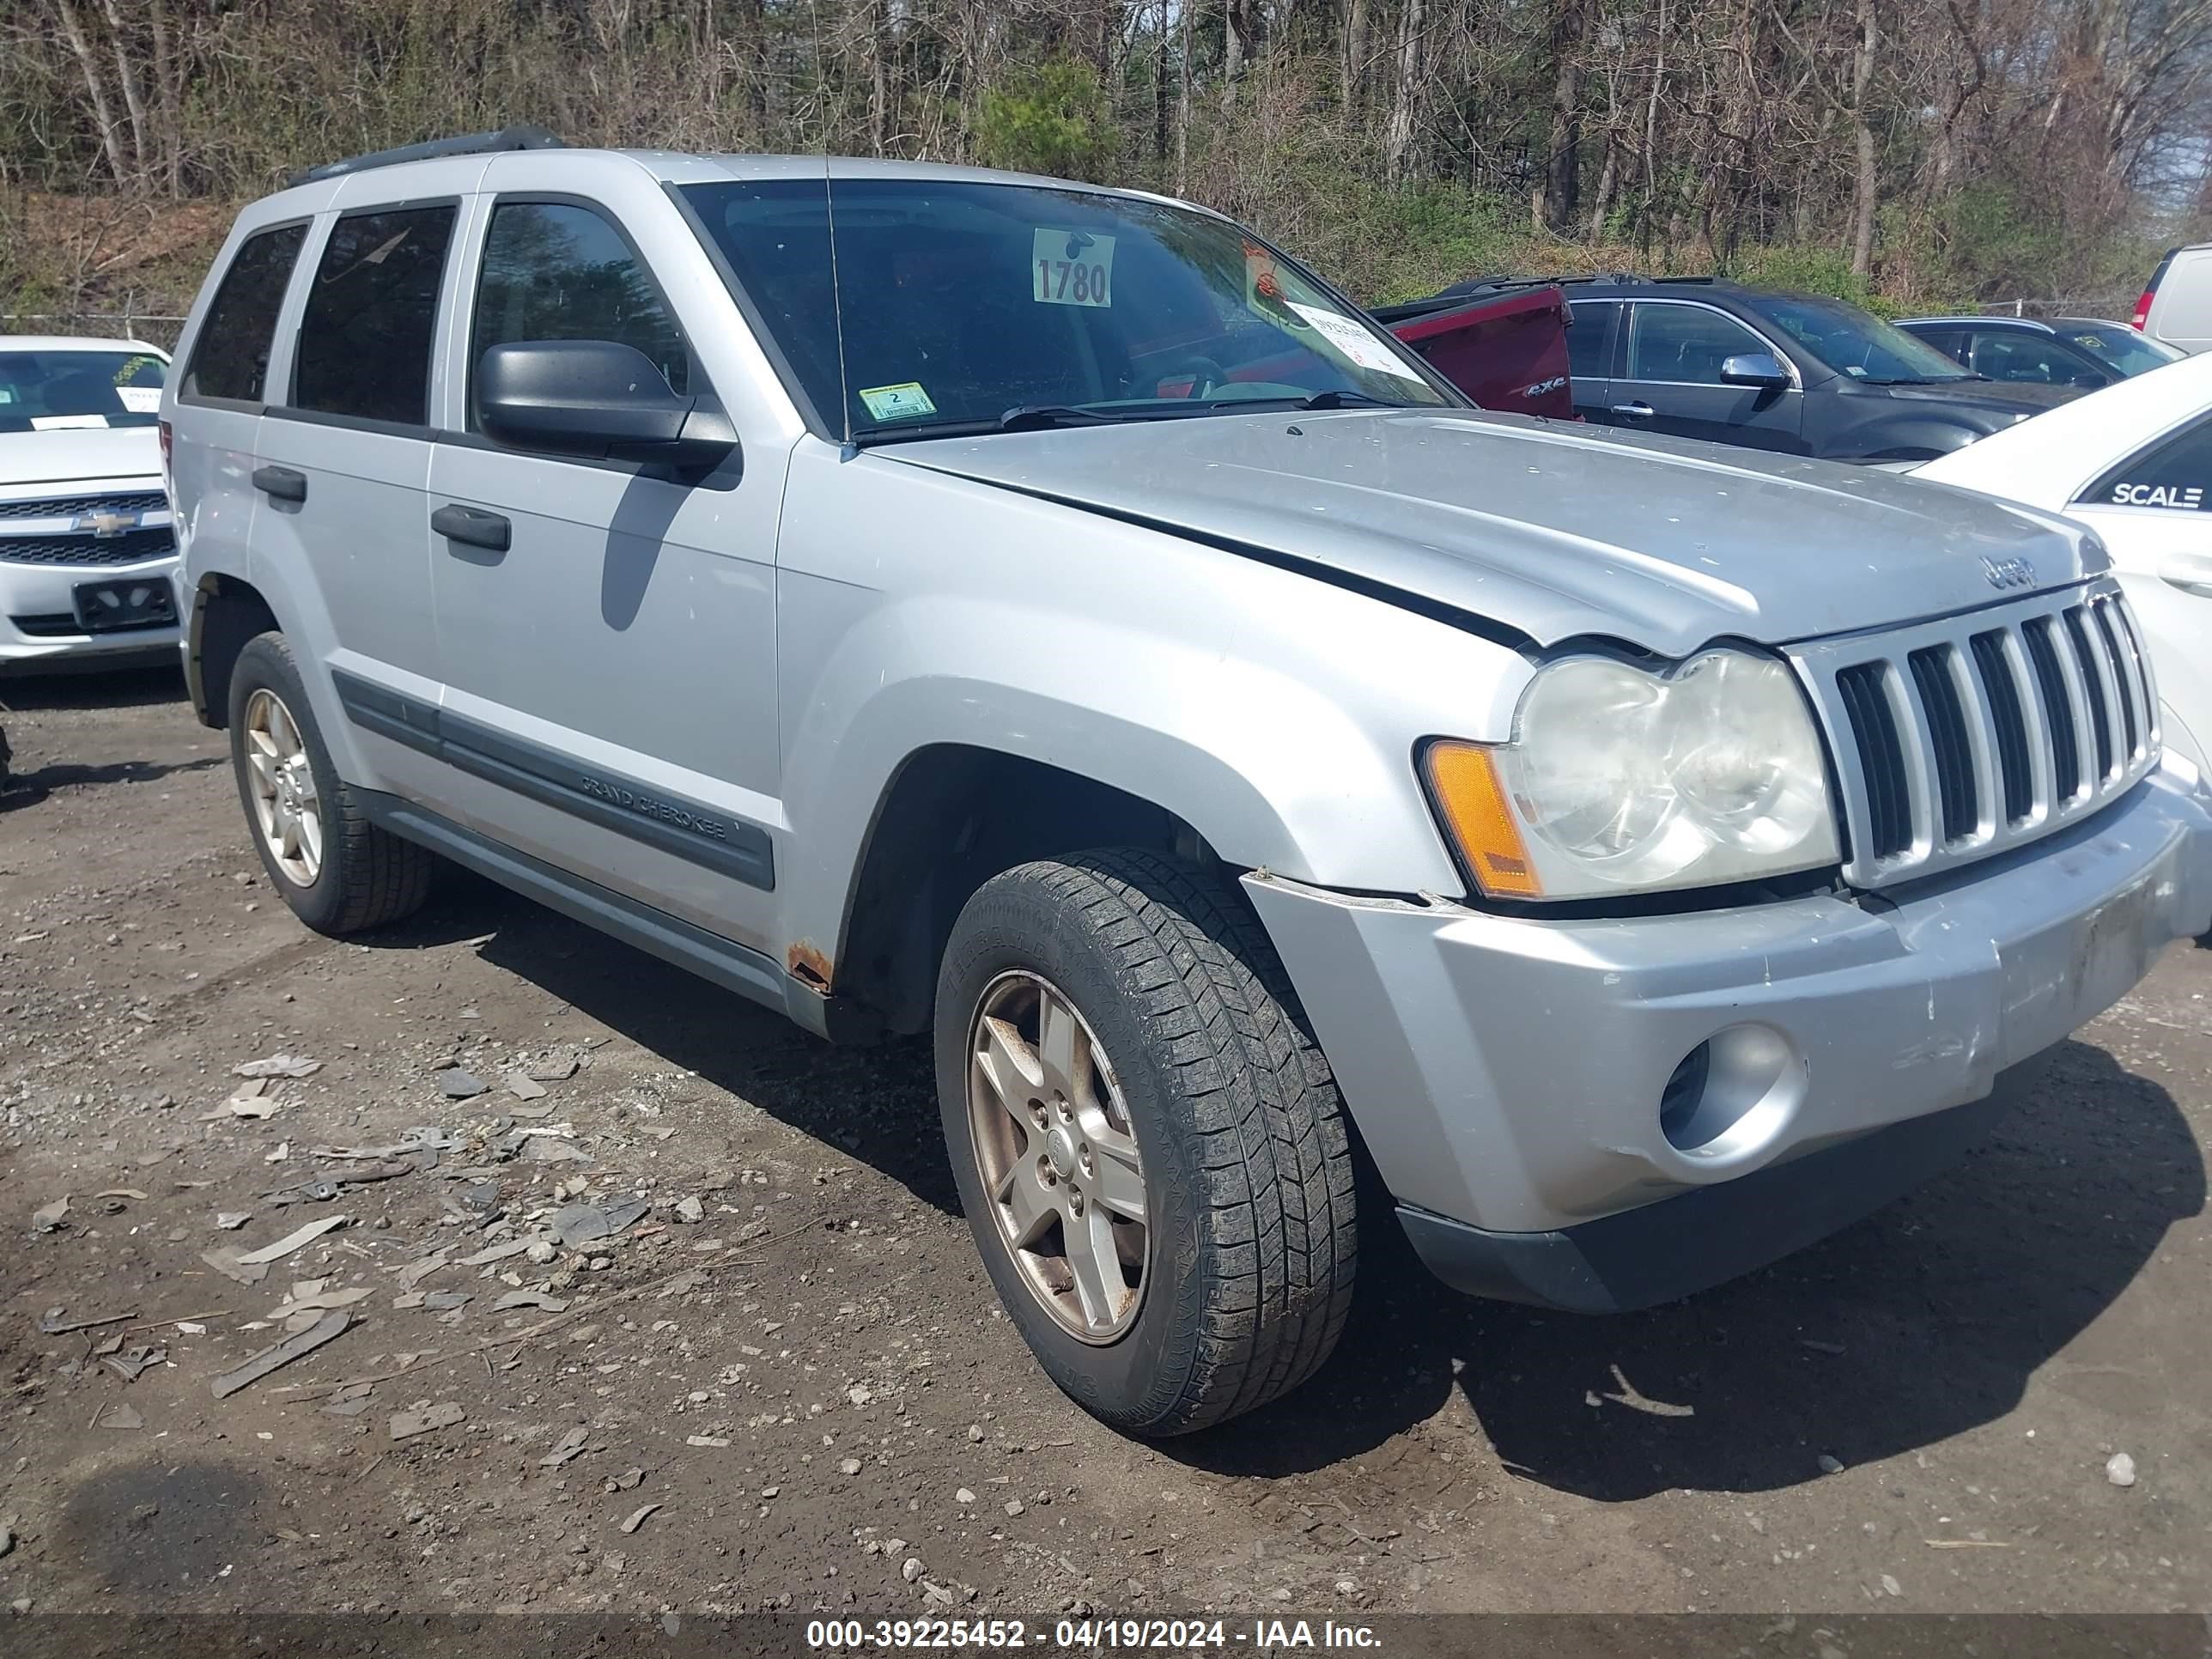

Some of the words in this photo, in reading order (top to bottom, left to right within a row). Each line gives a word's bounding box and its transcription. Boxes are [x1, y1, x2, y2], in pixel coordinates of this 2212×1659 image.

[1038, 258, 1106, 304] 1780
[889, 392, 902, 404] 2
[2112, 482, 2204, 508] SCALE
[1978, 556, 2038, 591] Jeep
[581, 775, 634, 807] GRAND
[639, 796, 726, 840] CHEROKEE
